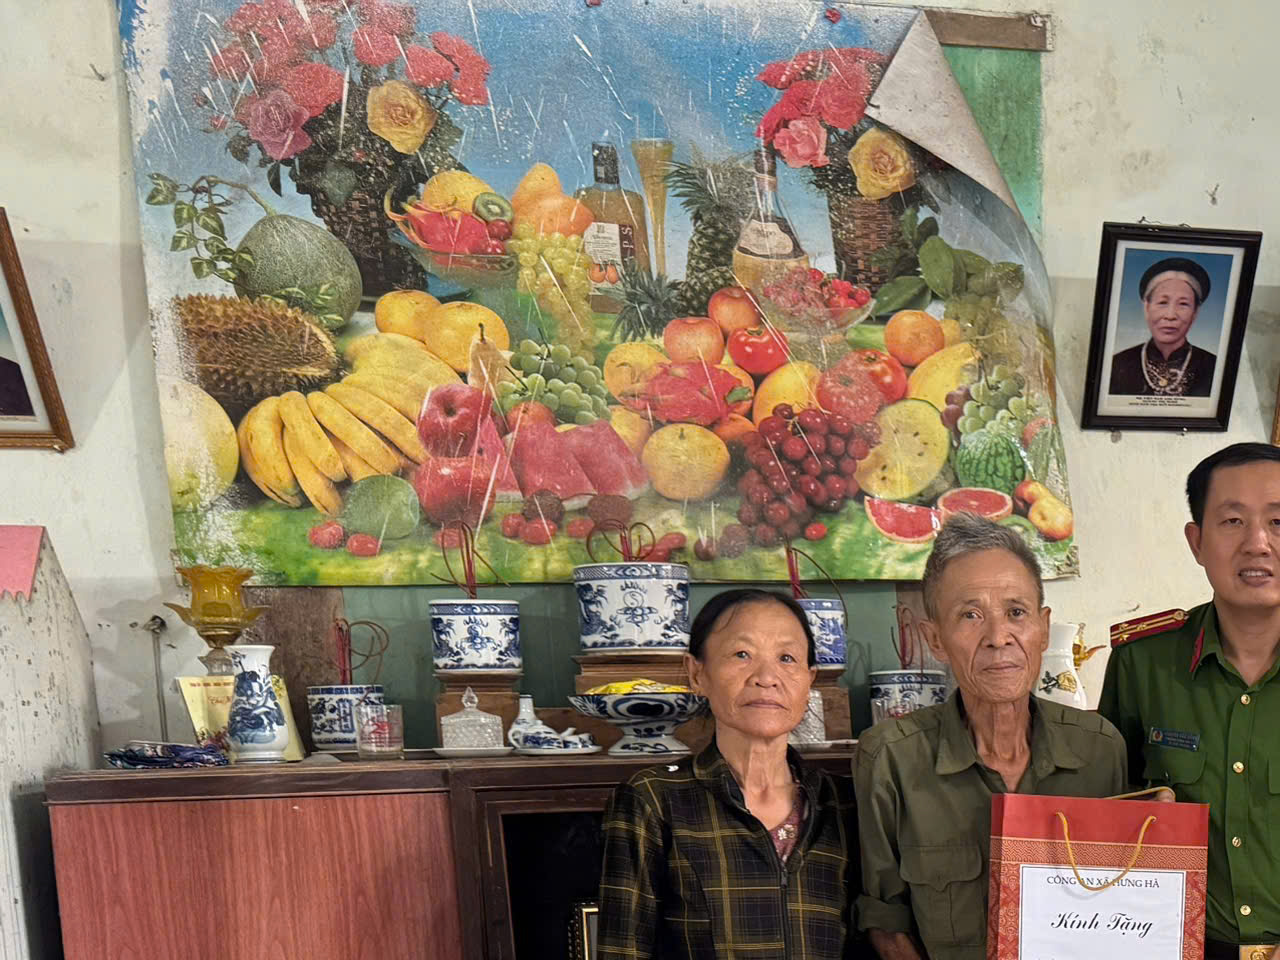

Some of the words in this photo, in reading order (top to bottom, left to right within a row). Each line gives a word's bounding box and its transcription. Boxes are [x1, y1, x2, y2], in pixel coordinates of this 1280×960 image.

[1047, 875, 1077, 885] CÔNG
[1097, 876, 1109, 887] XÃ
[1144, 877, 1160, 888] HÀ
[1051, 911, 1099, 930] Kính
[1107, 912, 1153, 938] Tặng
